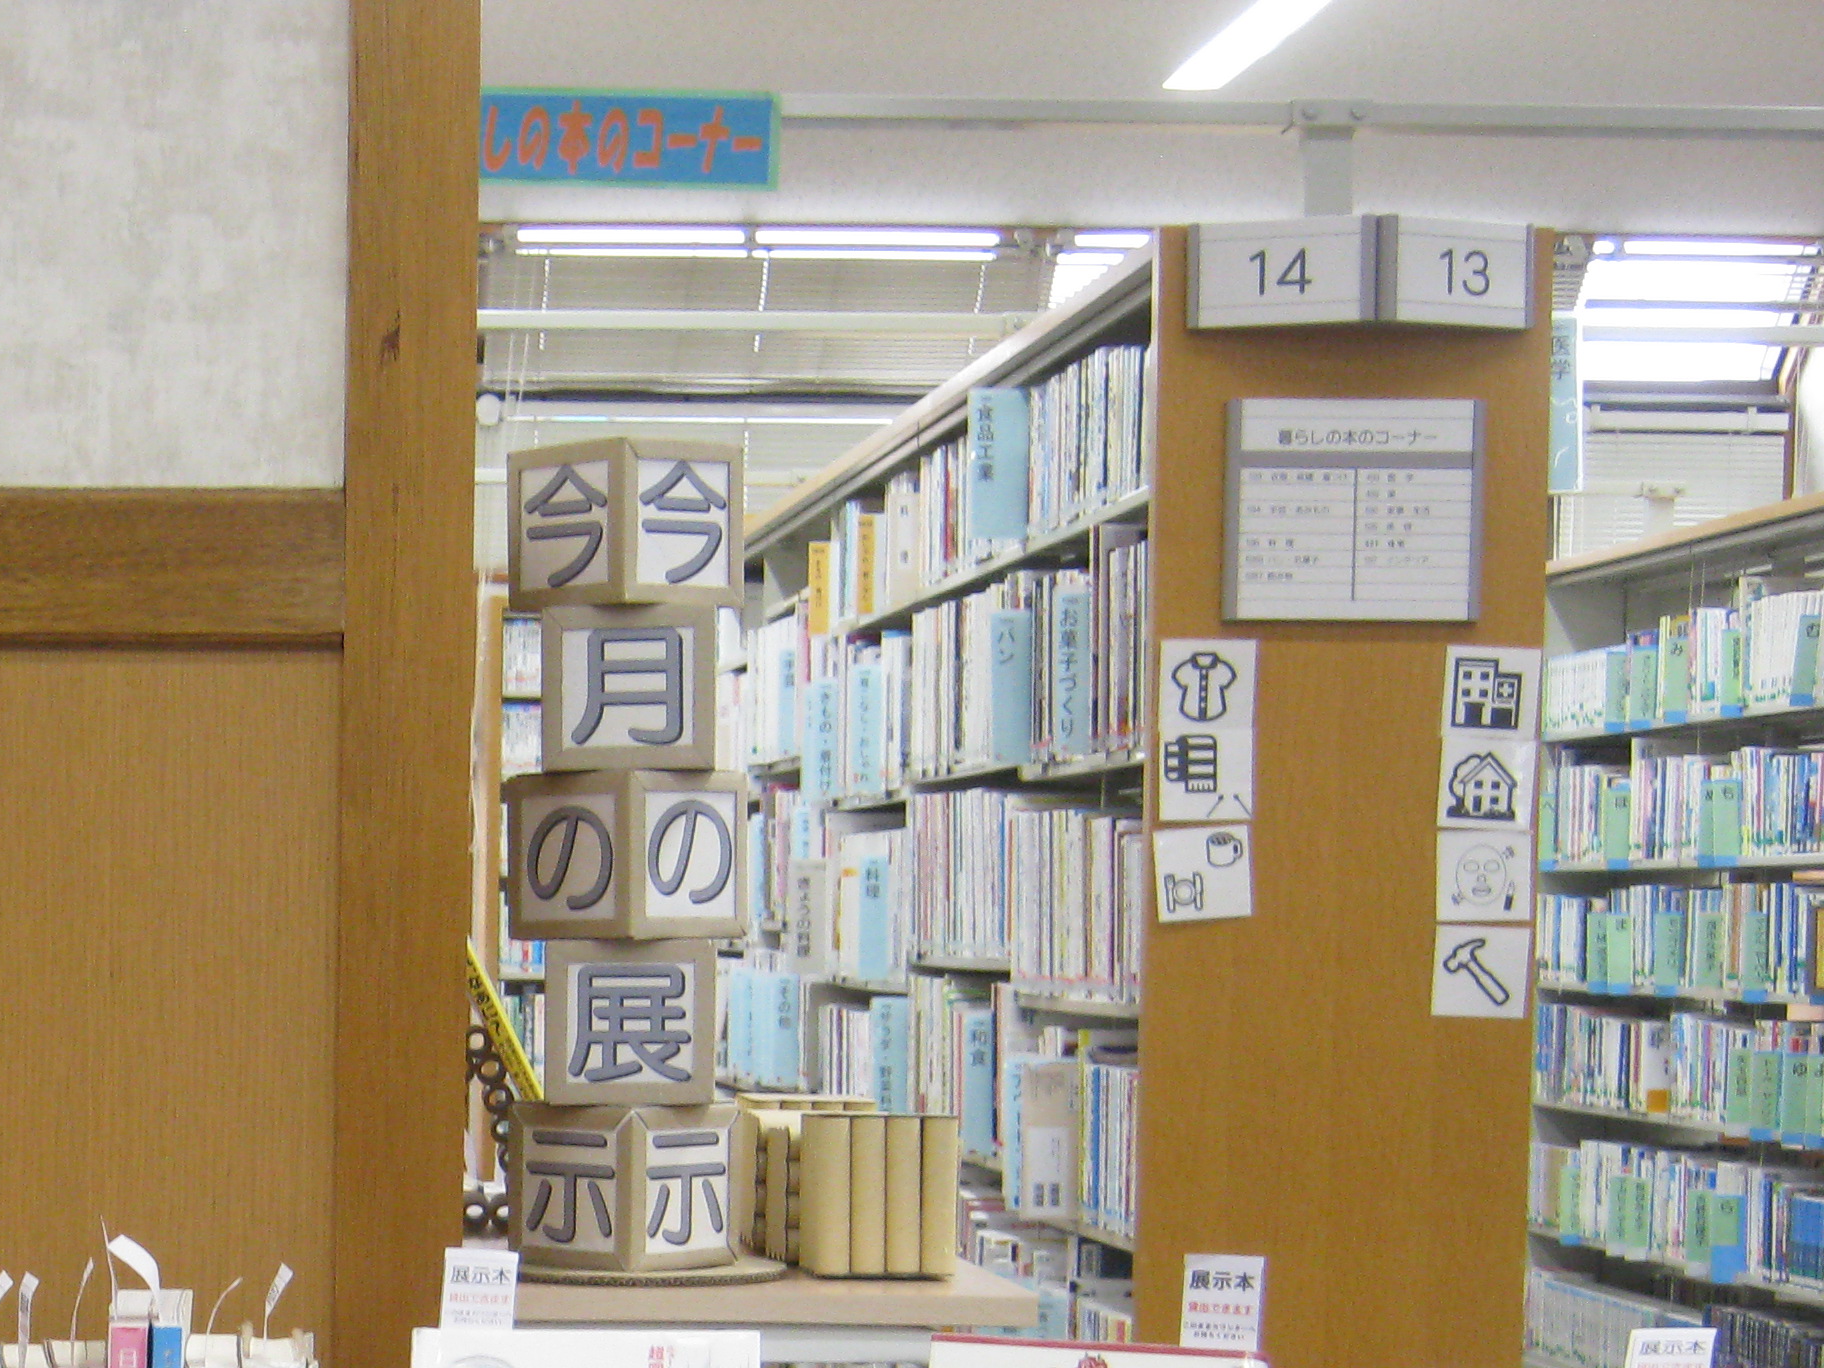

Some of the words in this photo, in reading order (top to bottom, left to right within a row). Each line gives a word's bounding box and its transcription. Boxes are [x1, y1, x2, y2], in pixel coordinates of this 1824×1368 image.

[481, 100, 763, 174] しの本のコーナー
[1248, 248, 1312, 297] 14
[1439, 249, 1491, 297] 13
[1552, 335, 1571, 380] 医学
[1278, 428, 1438, 446] 暮らしの本のコーナー
[525, 463, 608, 587] 今
[640, 459, 727, 584] 今
[571, 626, 687, 745] 月
[526, 806, 613, 910] の
[647, 800, 732, 904] の
[568, 963, 691, 1082] 展
[526, 1131, 615, 1243] 示
[646, 1131, 725, 1245] 示
[451, 1265, 512, 1285] 展示本
[1189, 1268, 1255, 1292] 展示本
[1640, 1339, 1706, 1355] 展示本
